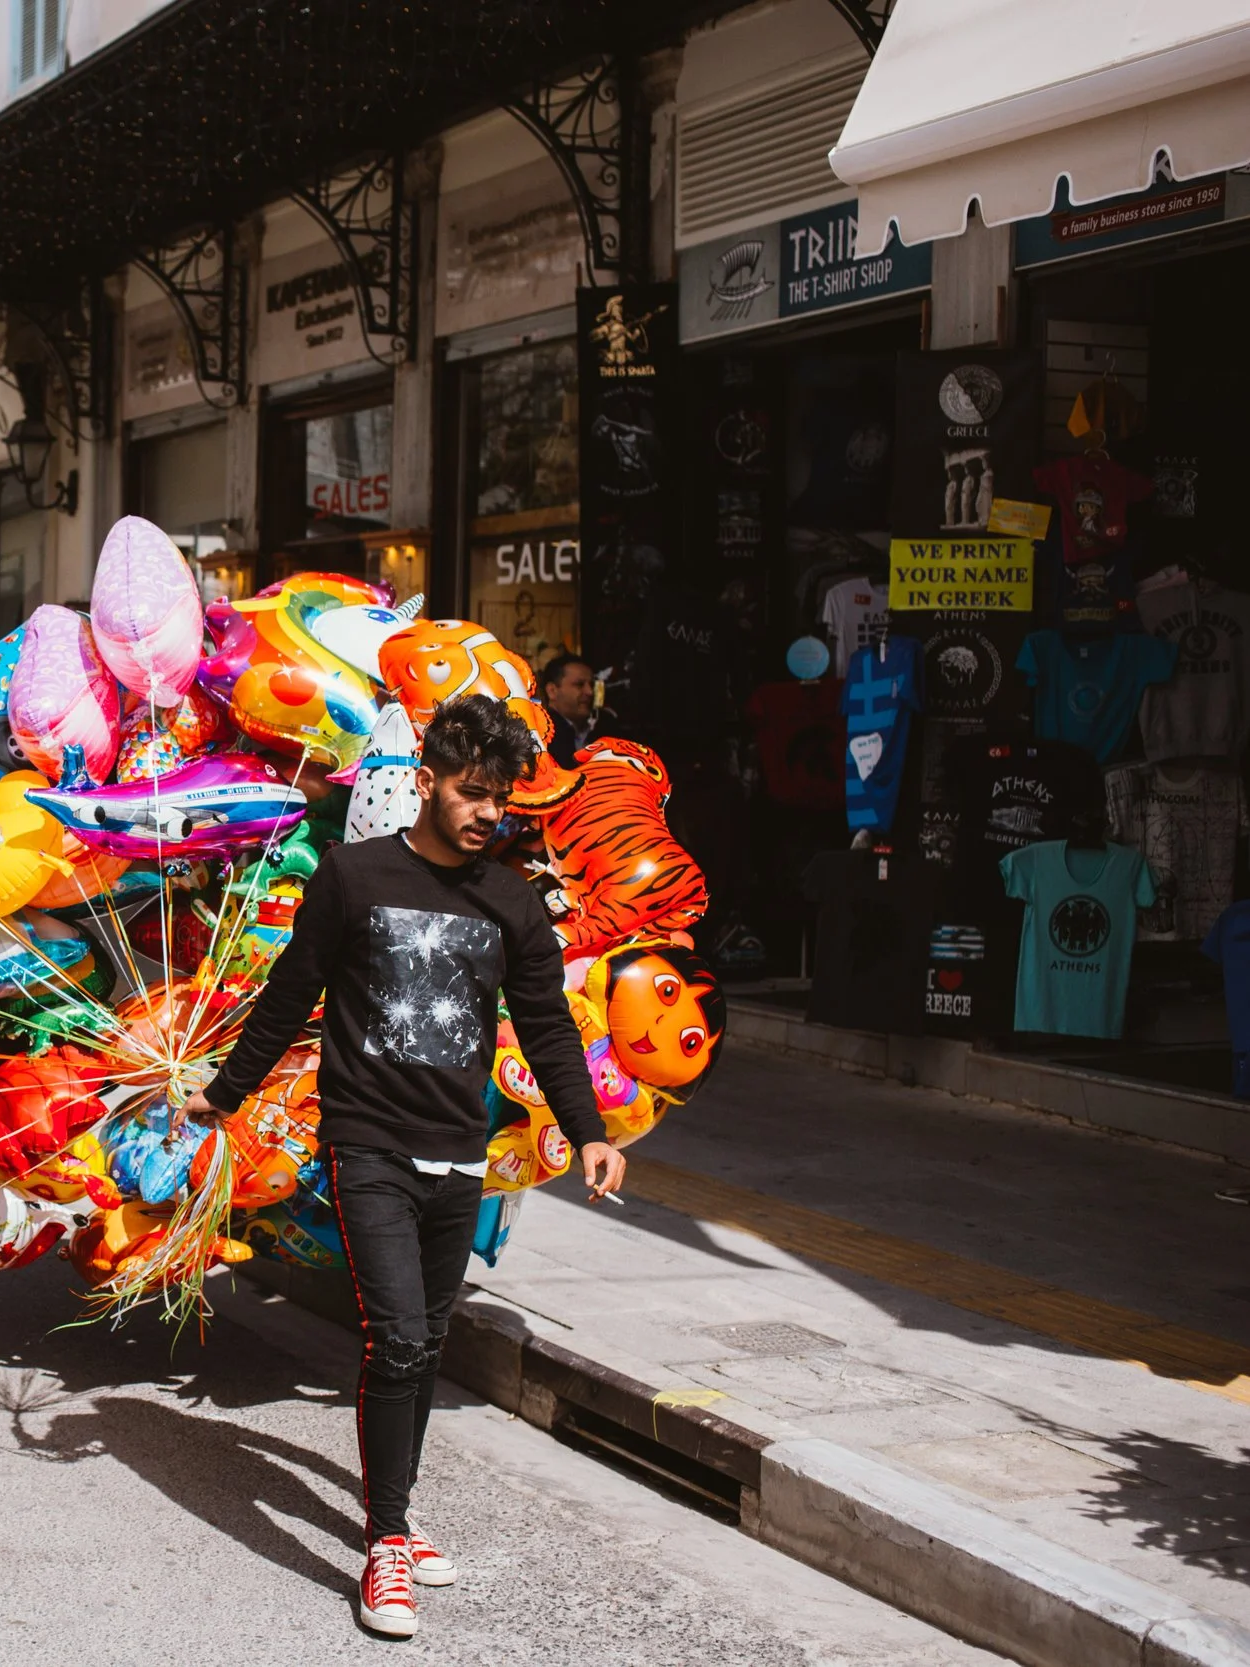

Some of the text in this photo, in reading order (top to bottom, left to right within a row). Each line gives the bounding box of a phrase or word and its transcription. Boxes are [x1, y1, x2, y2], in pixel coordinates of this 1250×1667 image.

[1070, 216, 1098, 235] family
[1100, 210, 1139, 228] business
[1141, 202, 1165, 217] store
[1168, 195, 1193, 212] since
[1196, 187, 1220, 205] 1950
[788, 258, 893, 304] THE T-SHIRT SHOP
[947, 426, 990, 437] GREECE
[313, 474, 390, 519] SALES
[909, 542, 1017, 559] WE PRINT
[896, 567, 1028, 583] YOUR NAME
[908, 590, 1014, 607] IN GREEK
[934, 611, 986, 621] ATHENS
[992, 776, 1054, 804] ATHENS
[1050, 961, 1101, 974] ATHENS
[926, 993, 972, 1017] REECE
